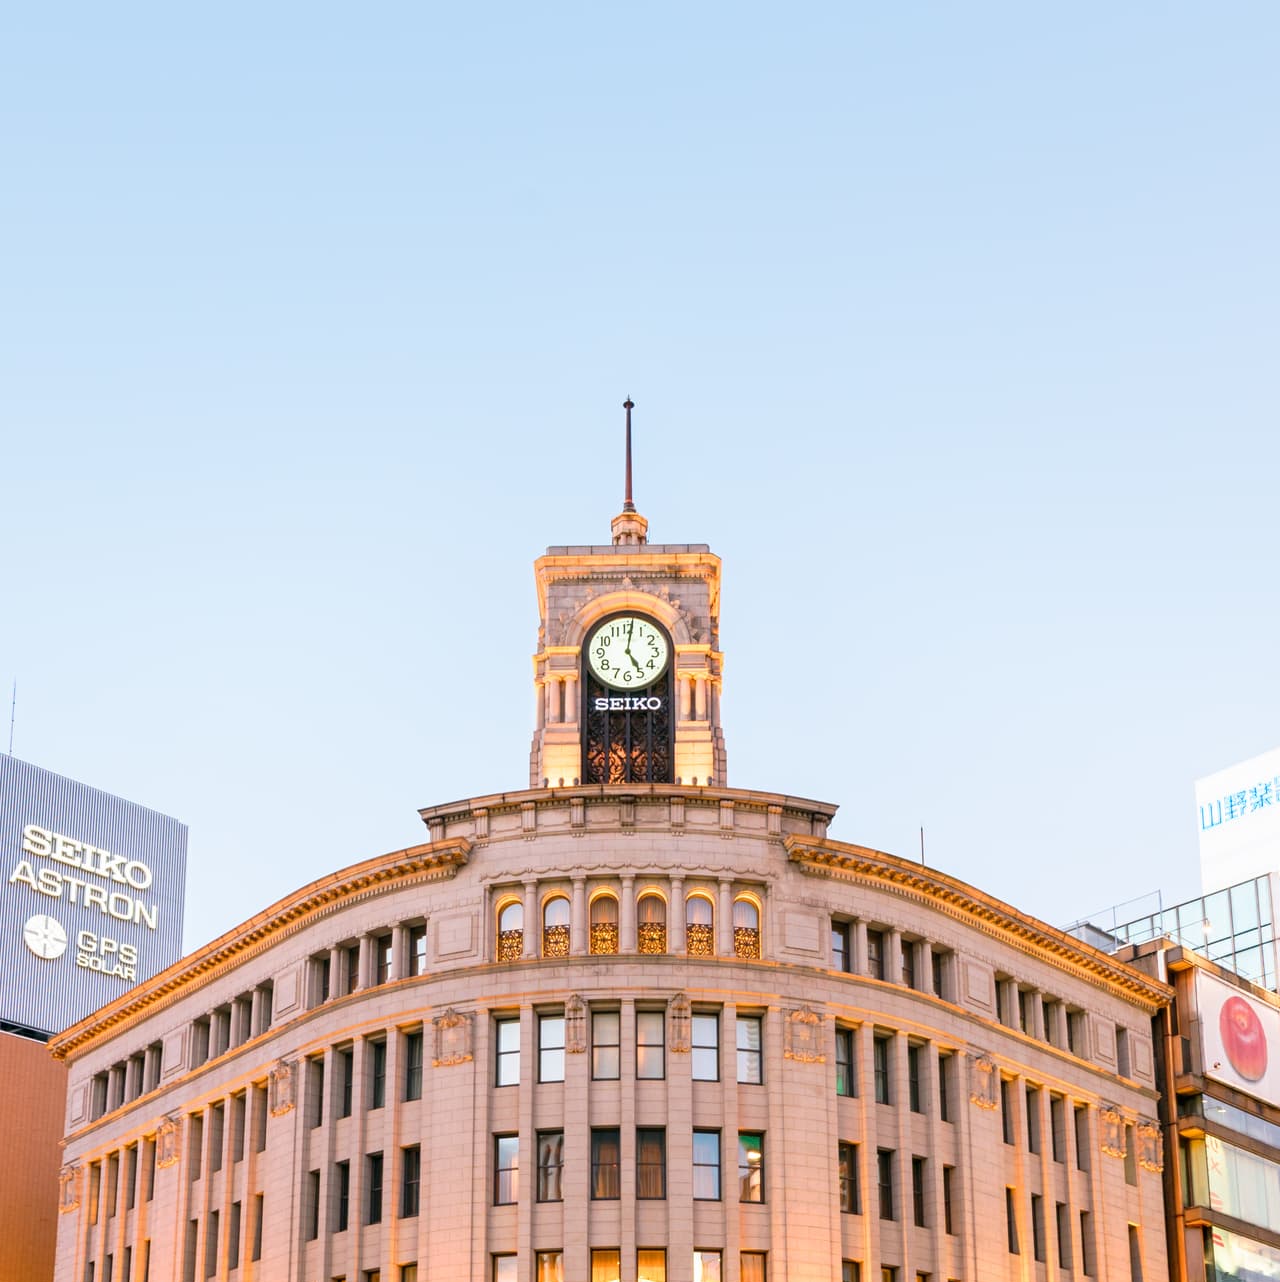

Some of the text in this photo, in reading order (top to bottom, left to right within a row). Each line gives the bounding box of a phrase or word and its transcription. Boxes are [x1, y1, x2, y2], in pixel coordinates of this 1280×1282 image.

[595, 697, 661, 711] SEIKO
[23, 824, 152, 891] SEIKO
[9, 859, 157, 930] ASTRON
[77, 930, 138, 965] GPS
[76, 954, 137, 983] SOLAR
